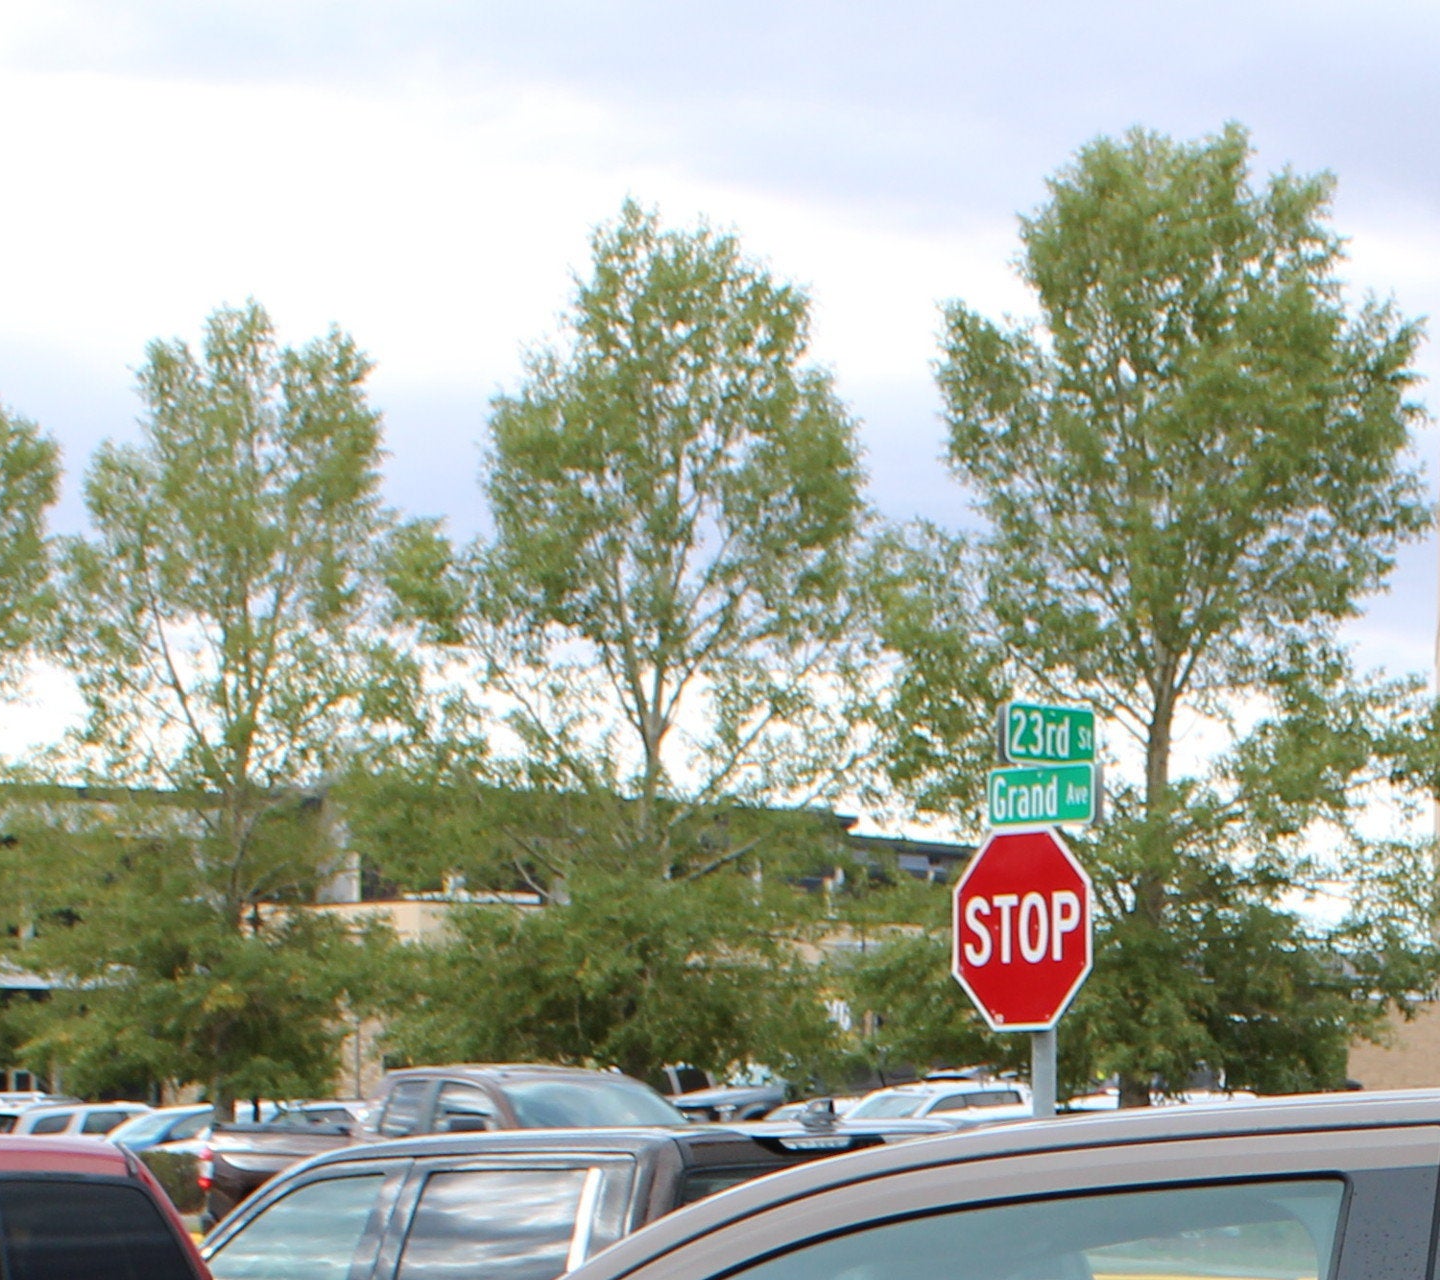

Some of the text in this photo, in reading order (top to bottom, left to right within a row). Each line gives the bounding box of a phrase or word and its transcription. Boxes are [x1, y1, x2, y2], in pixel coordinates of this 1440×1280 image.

[1010, 709, 1093, 758] 23rd St
[993, 775, 1089, 821] Grand Ave
[964, 889, 1081, 967] STOP
